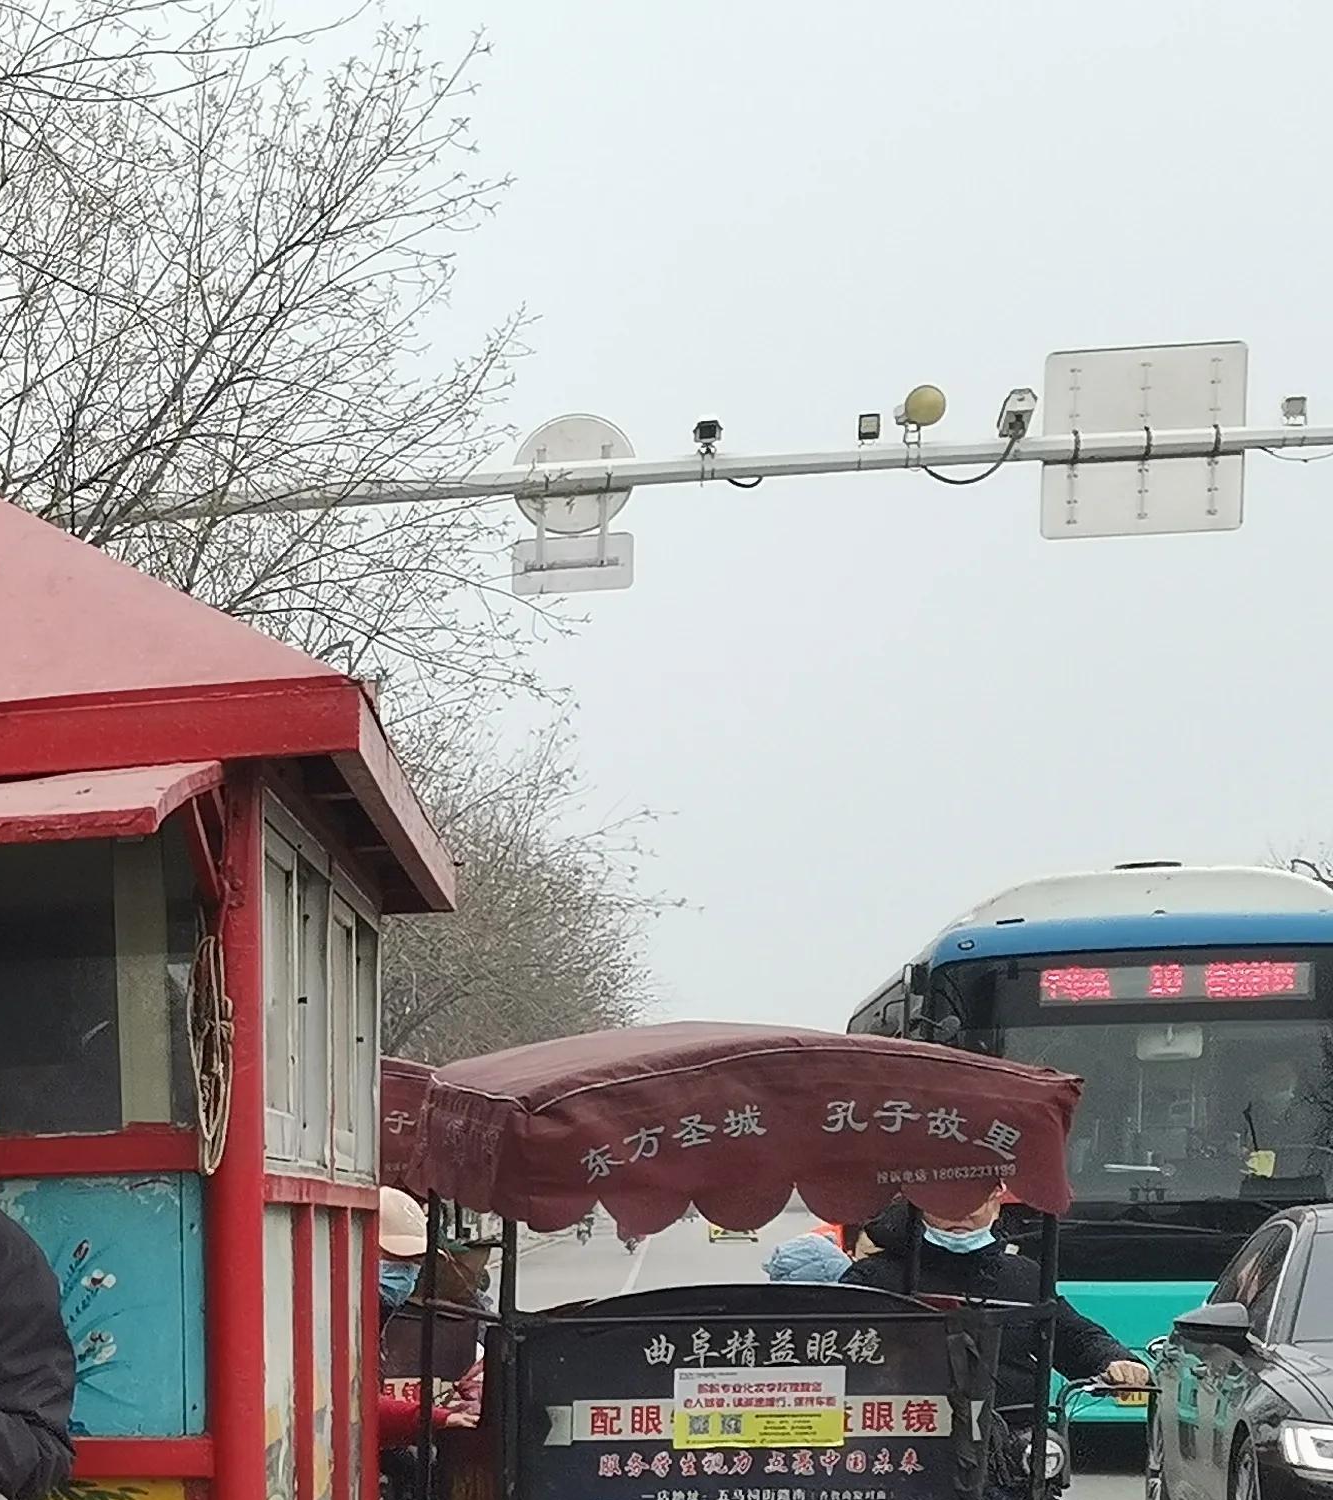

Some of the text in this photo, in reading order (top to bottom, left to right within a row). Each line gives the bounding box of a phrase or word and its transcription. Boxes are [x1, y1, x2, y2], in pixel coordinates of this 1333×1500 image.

[384, 1110, 416, 1134] 子
[581, 1105, 767, 1184] 东方圣城
[822, 1100, 1022, 1161] 孔子故里
[644, 1327, 885, 1367] 曲阜精益眼镜
[599, 1448, 925, 1477] 服务学生视力 点亮中国未来
